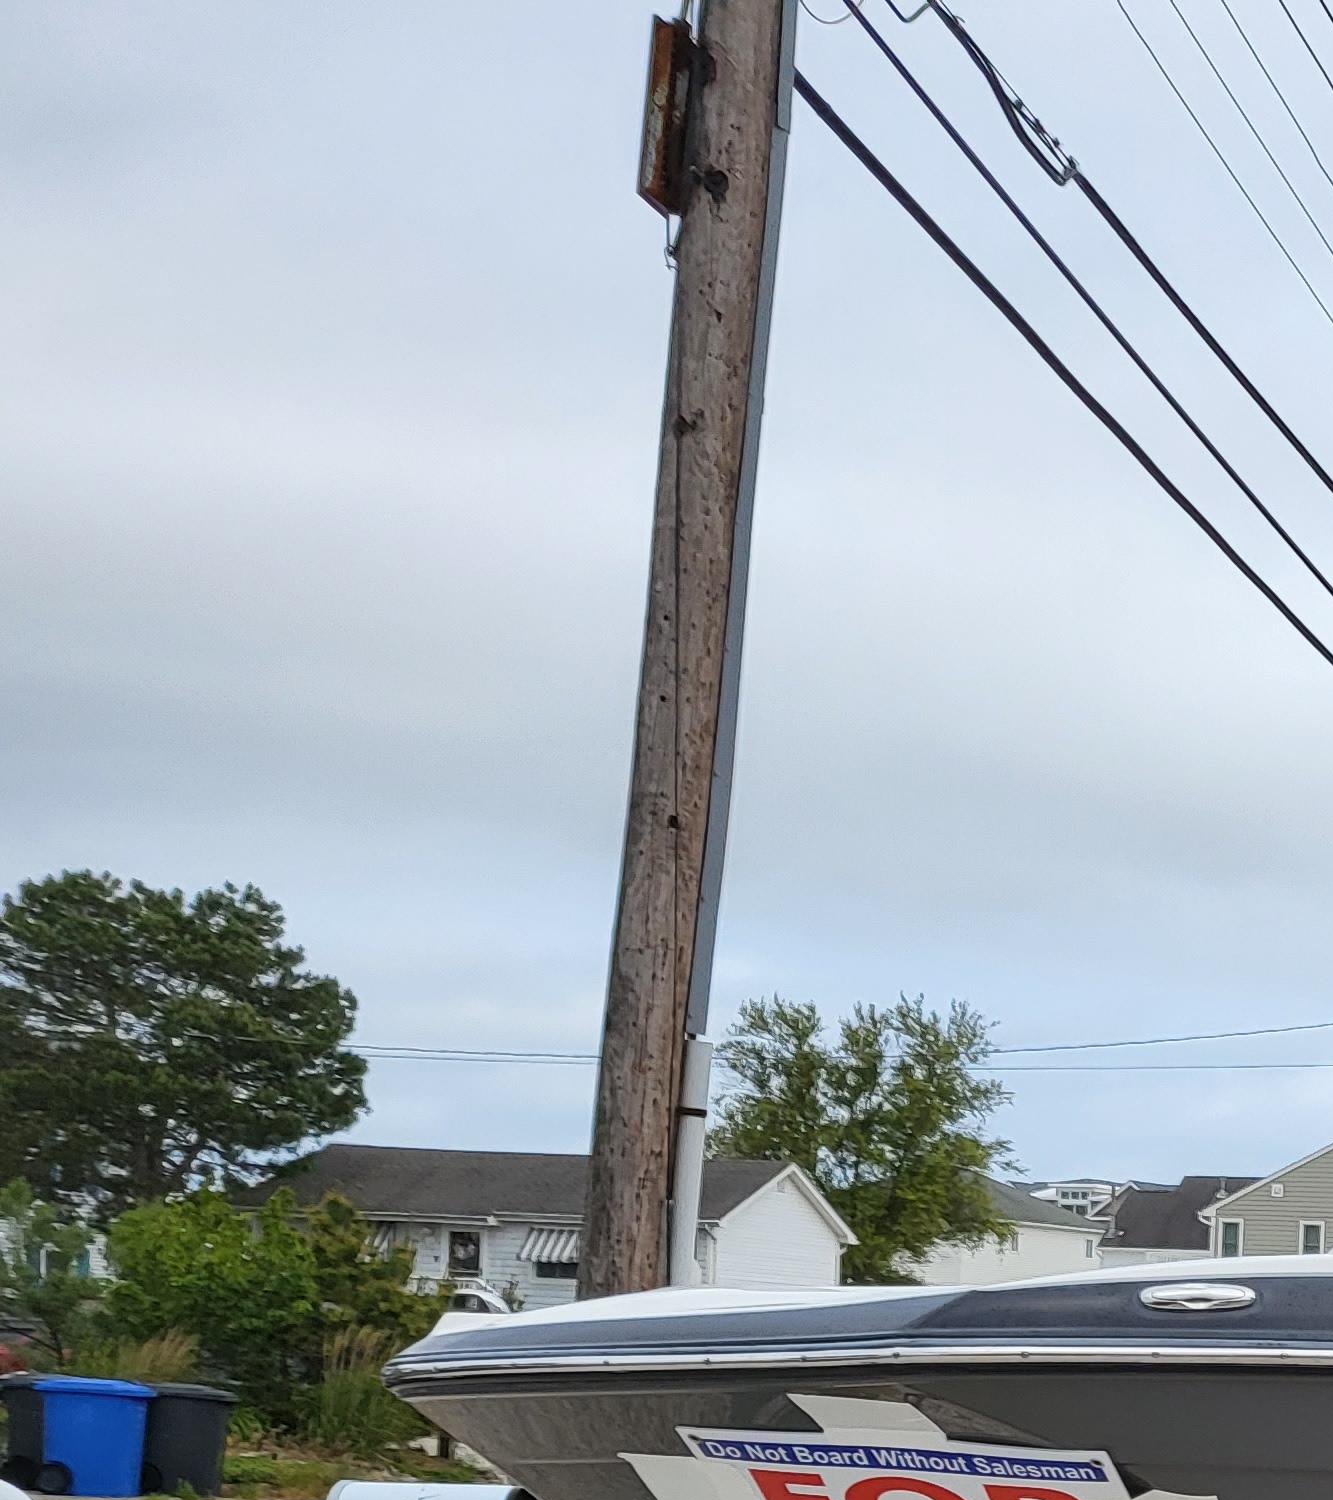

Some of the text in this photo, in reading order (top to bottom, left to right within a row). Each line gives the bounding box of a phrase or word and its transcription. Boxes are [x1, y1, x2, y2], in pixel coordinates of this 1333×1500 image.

[707, 1442, 1097, 1481] Do Not Board Without Salesman
